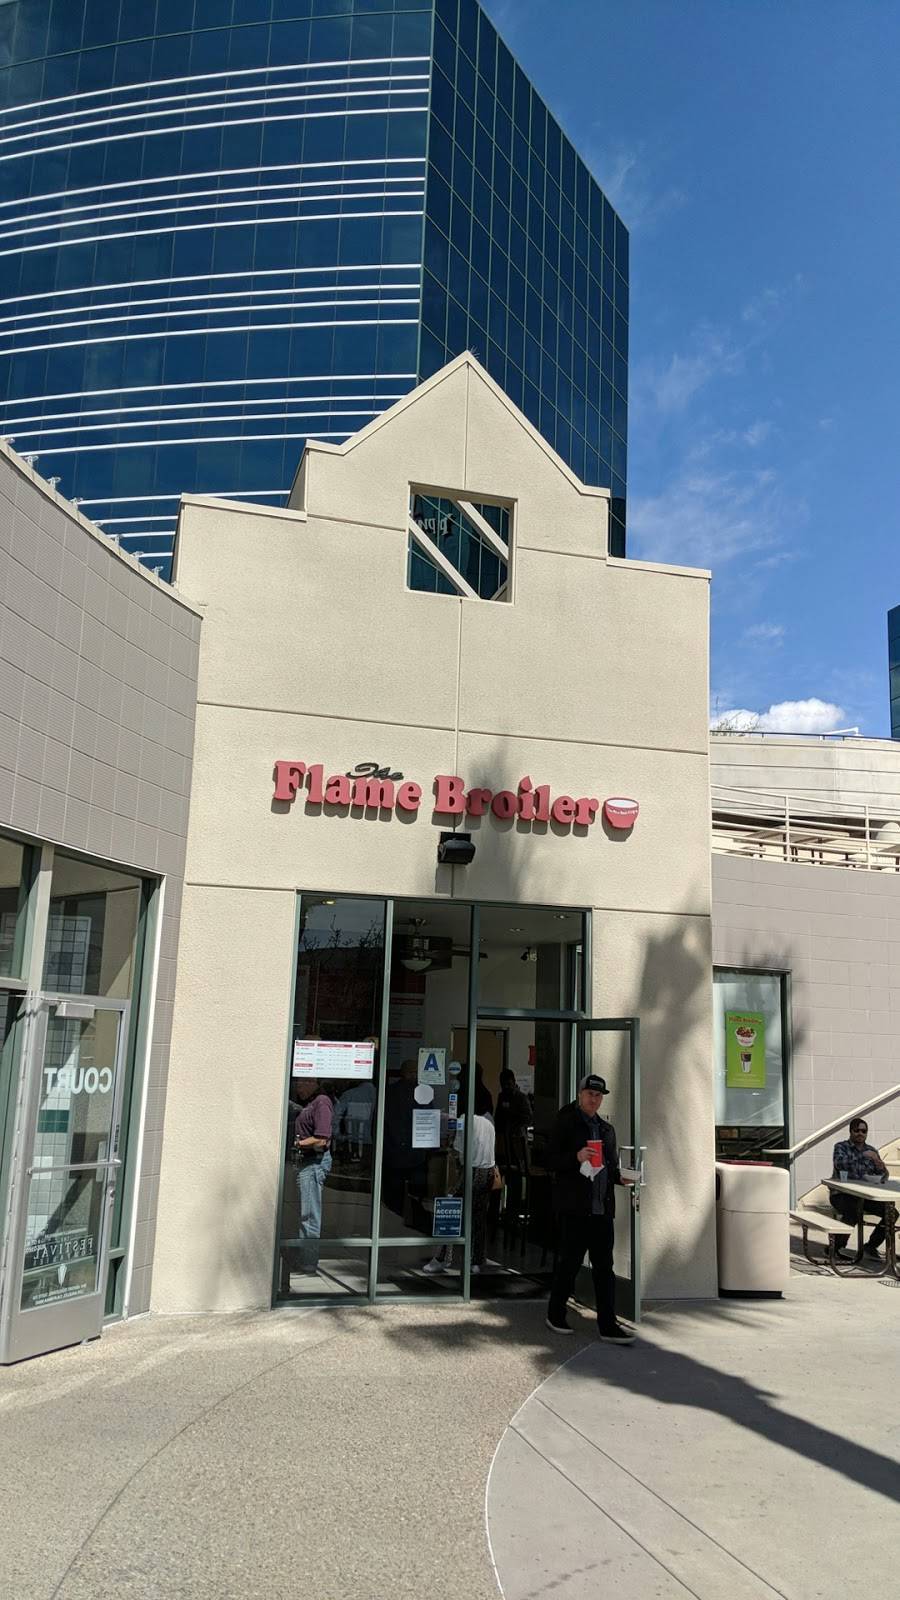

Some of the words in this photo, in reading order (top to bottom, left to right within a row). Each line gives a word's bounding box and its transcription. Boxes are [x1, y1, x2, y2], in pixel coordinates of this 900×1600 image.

[273, 760, 422, 810] Flame
[434, 775, 599, 824] Broiler
[423, 1053, 439, 1071] A
